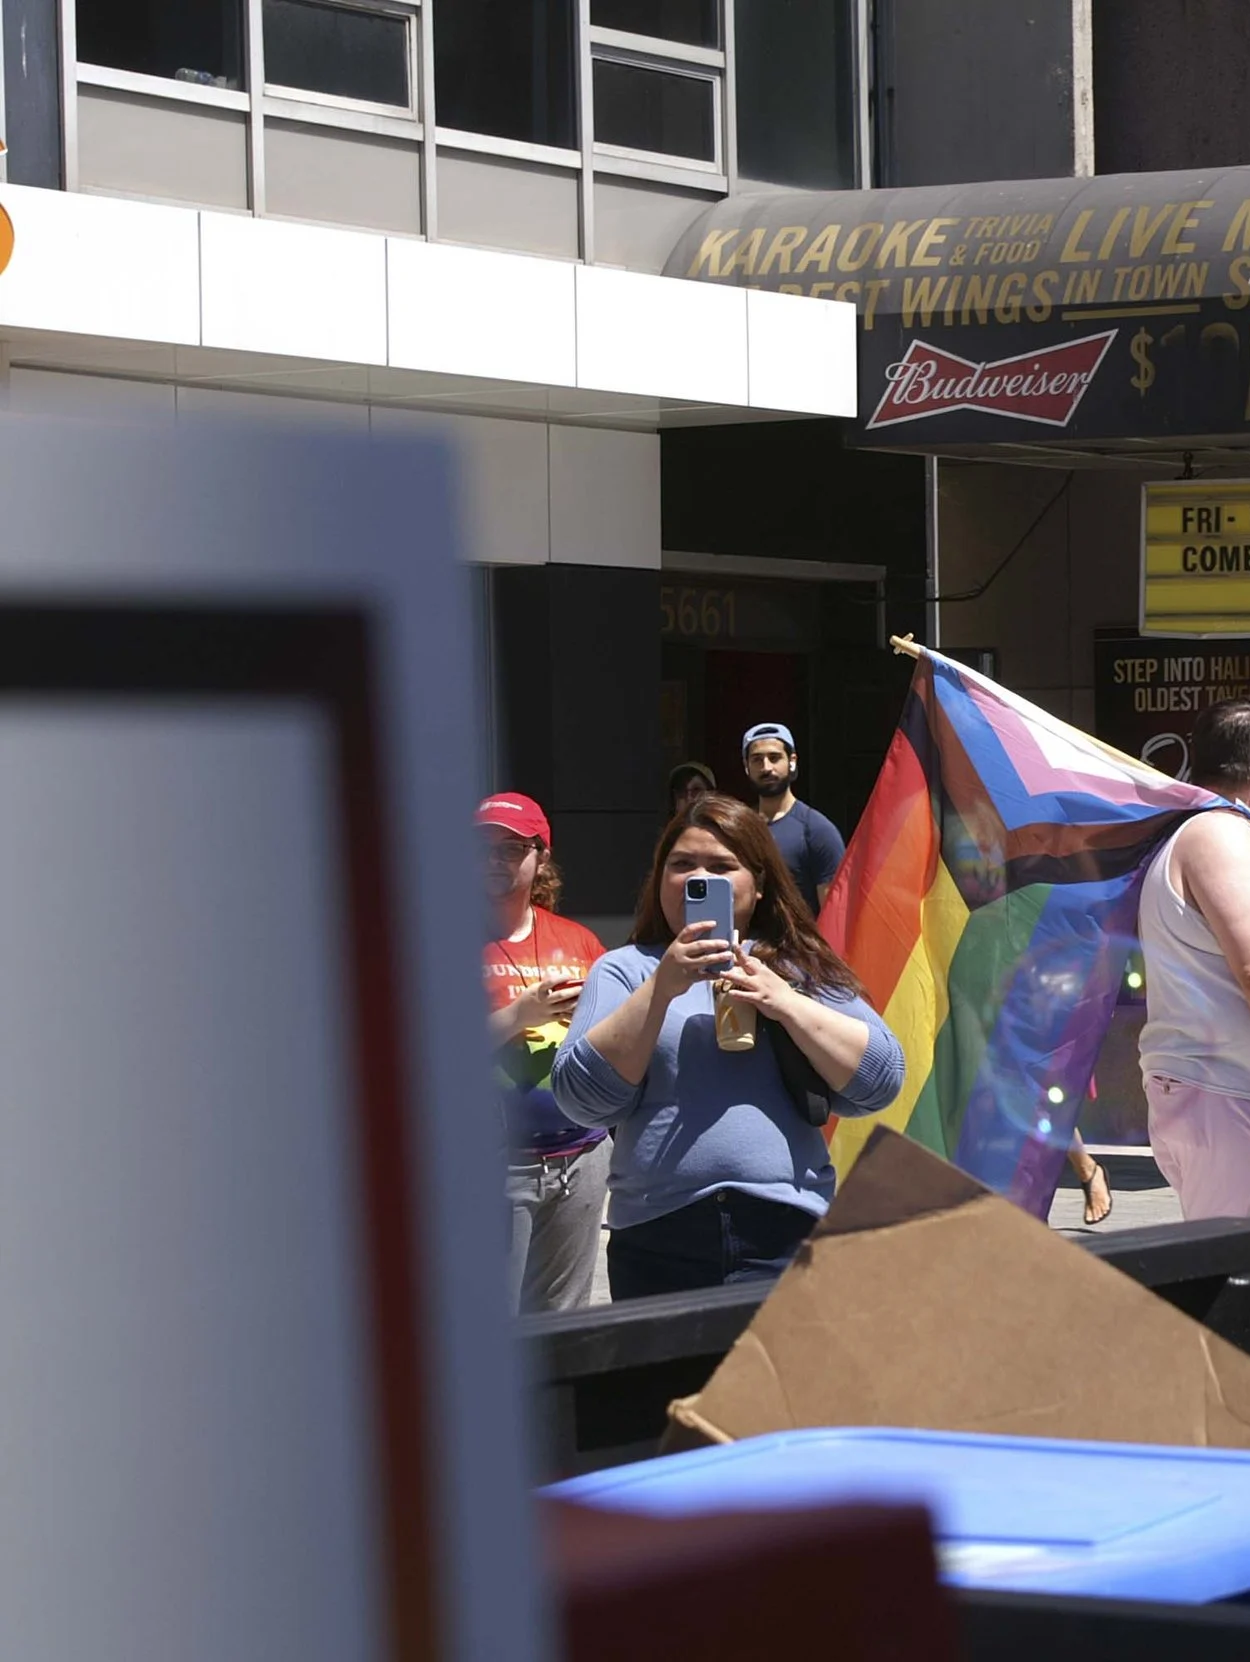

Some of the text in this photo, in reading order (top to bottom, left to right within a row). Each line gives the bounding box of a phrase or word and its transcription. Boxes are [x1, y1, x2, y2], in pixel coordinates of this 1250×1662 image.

[688, 217, 962, 277] KARAOKE
[965, 212, 1054, 238] TRIVIA
[1059, 199, 1215, 264] LIVE
[949, 239, 1040, 267] & FOOD
[900, 271, 1059, 329] WINGS
[1062, 270, 1101, 304] IN
[1113, 262, 1209, 301] TOWN
[885, 357, 1093, 406] Budweiser
[660, 586, 736, 638] 5661
[1113, 658, 1158, 684] STEP
[1163, 656, 1205, 683] INTO
[1134, 686, 1202, 712] OLDEST
